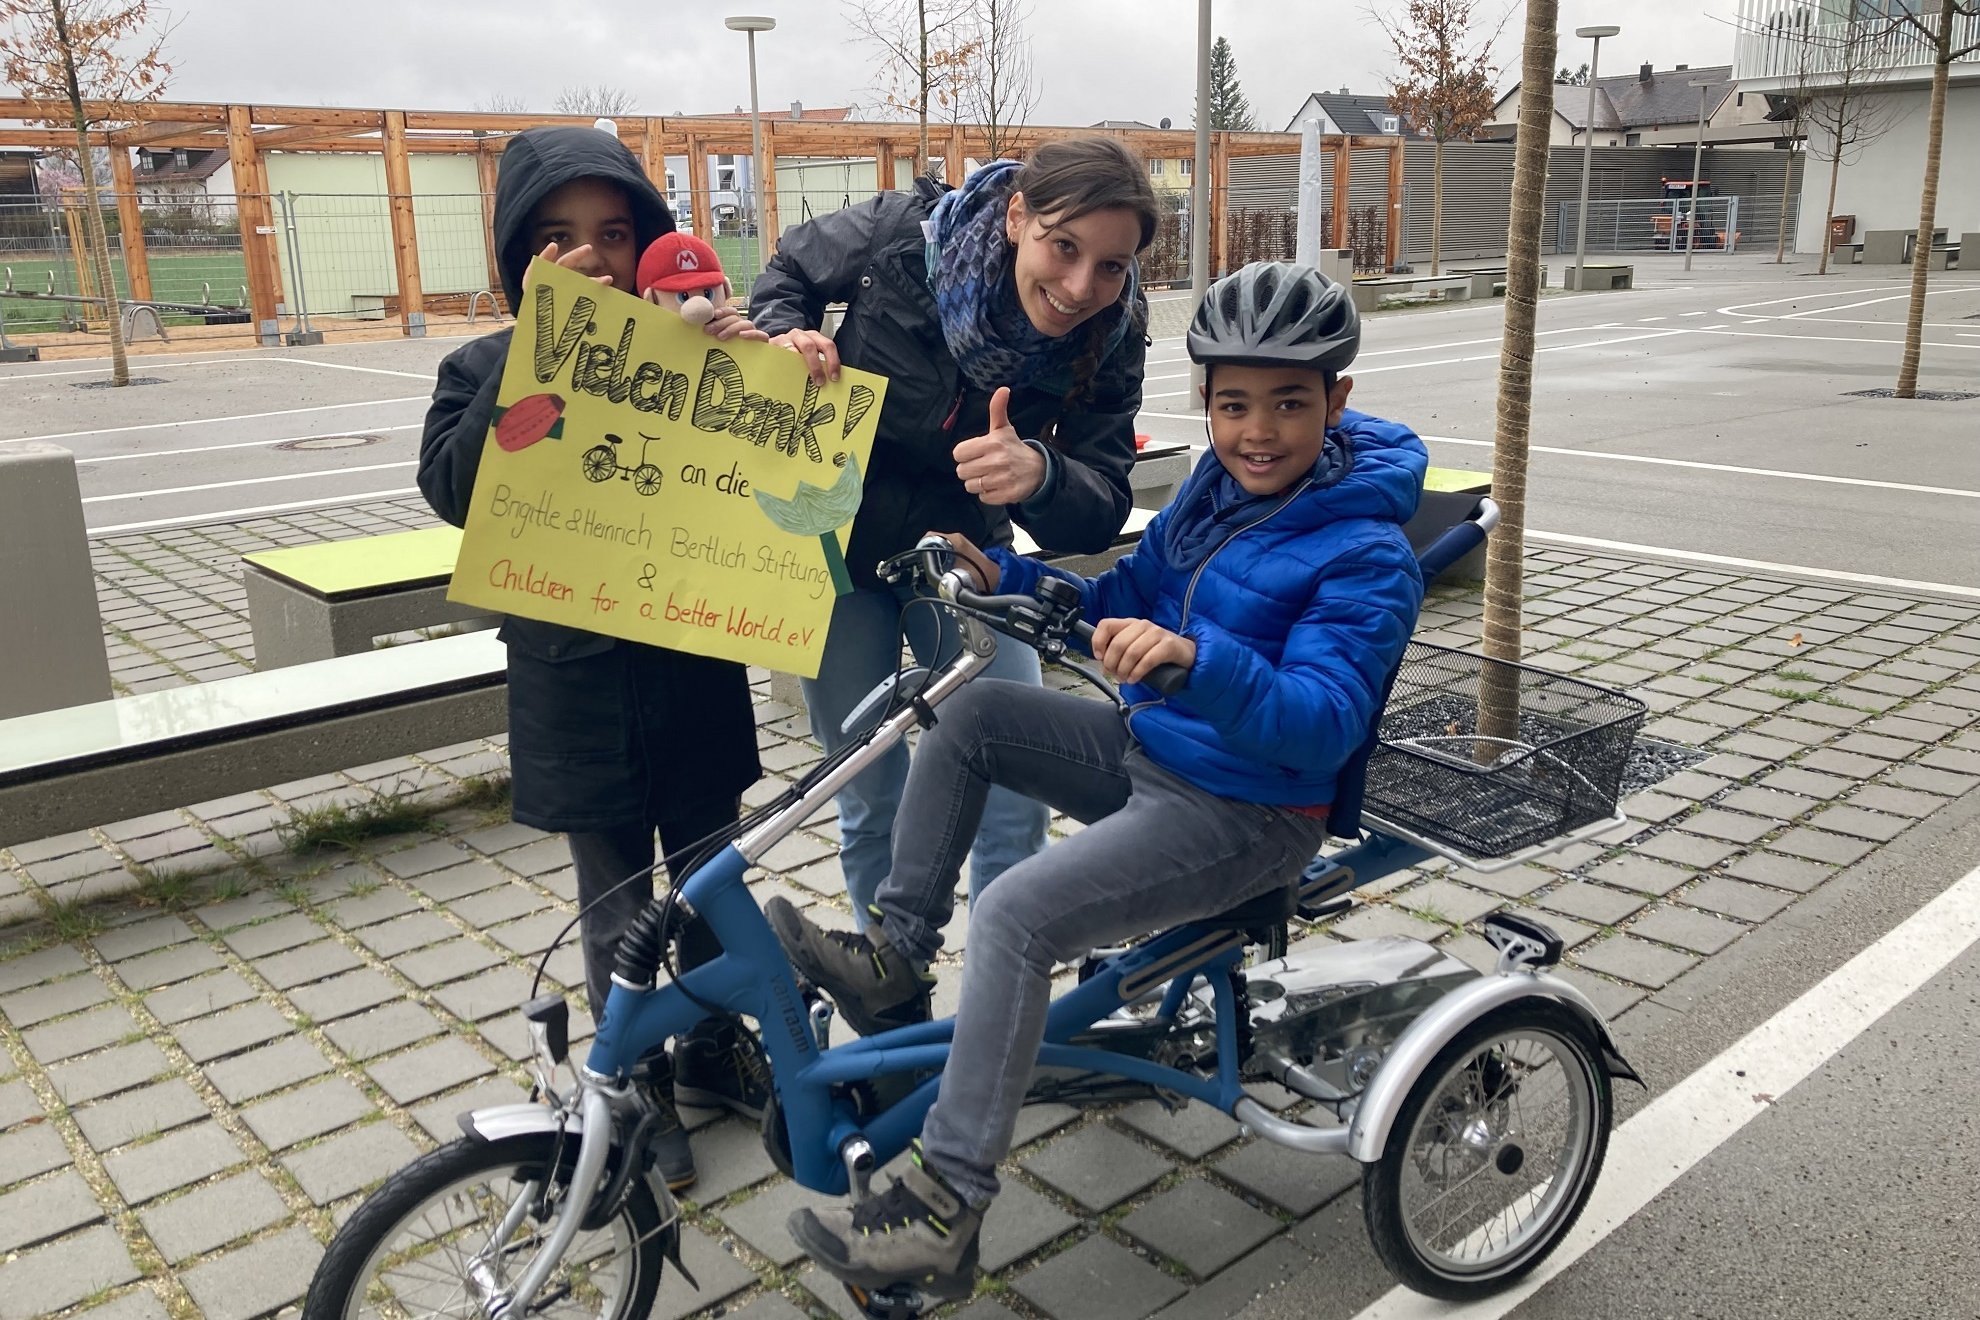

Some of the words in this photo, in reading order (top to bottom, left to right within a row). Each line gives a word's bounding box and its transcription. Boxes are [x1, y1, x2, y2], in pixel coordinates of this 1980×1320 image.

[679, 252, 698, 268] M
[535, 284, 688, 421] Vielen
[692, 349, 875, 468] Dank!
[681, 464, 706, 486] an
[716, 461, 750, 497] die
[490, 485, 561, 538] Brigitte
[565, 509, 583, 534] &
[583, 508, 652, 550] Heinrich
[670, 527, 746, 569] Bertlich
[752, 545, 829, 600] Stiftung
[489, 559, 574, 602] Children
[591, 582, 619, 614] for
[639, 602, 657, 620] a
[664, 592, 722, 627] better
[726, 606, 784, 643] World
[637, 562, 657, 592] &
